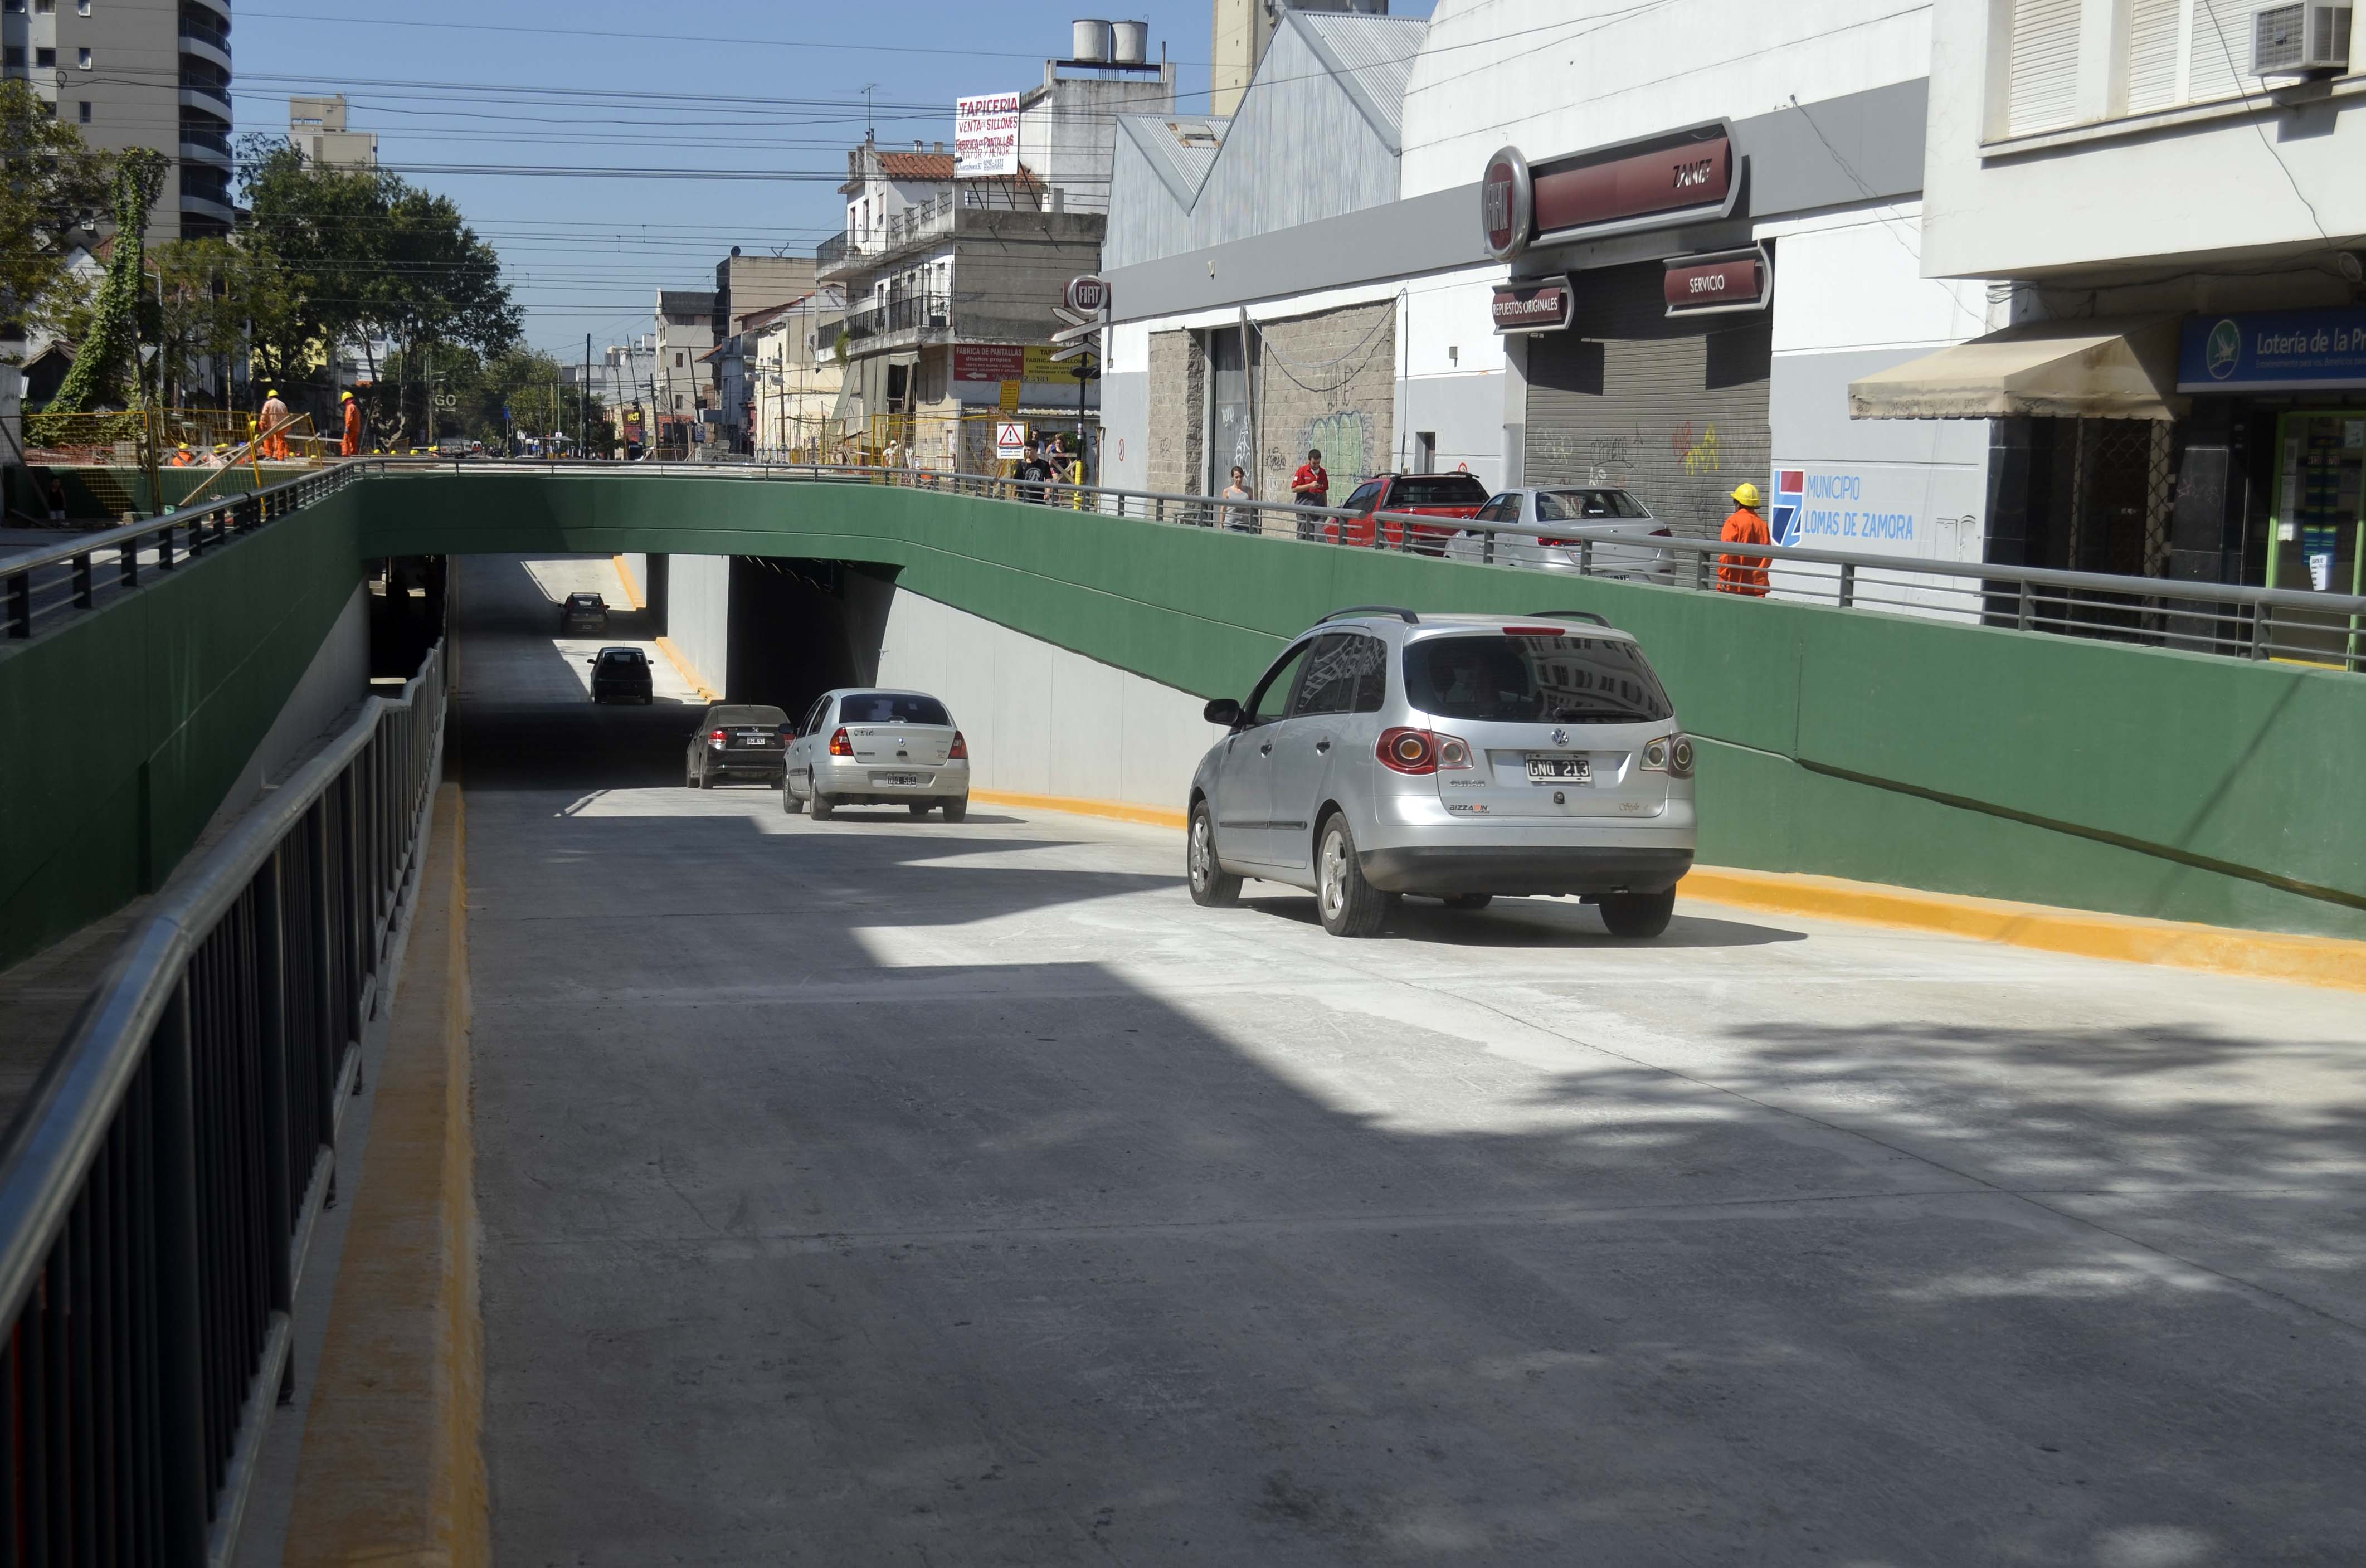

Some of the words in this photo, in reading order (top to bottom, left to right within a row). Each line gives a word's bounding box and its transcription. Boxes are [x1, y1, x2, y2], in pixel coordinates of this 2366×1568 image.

[960, 98, 1019, 118] TAPICERIA
[959, 119, 981, 133] VENTA
[987, 116, 1018, 130] SILLONES
[984, 134, 1014, 149] PANTALLAS
[961, 149, 982, 160] MAYOR
[989, 145, 1010, 158] MENOR
[1486, 181, 1511, 232] FIAT
[1690, 274, 1725, 293] SERVICIO
[1079, 286, 1101, 303] FIAT
[1493, 301, 1522, 316] REPUESTOS
[1523, 297, 1557, 313] ORIGINALES
[2257, 330, 2307, 354] Lotería
[2310, 328, 2330, 353] de
[2333, 327, 2348, 352] la
[990, 348, 1022, 357] PANTALLAS
[1807, 475, 1860, 500] MUNICIPIO
[1804, 510, 1840, 535] LOMAS
[1843, 512, 1858, 537] DE
[1861, 512, 1913, 540] ZAMORA
[1529, 761, 1555, 776] GNQ
[1562, 761, 1589, 776] 213
